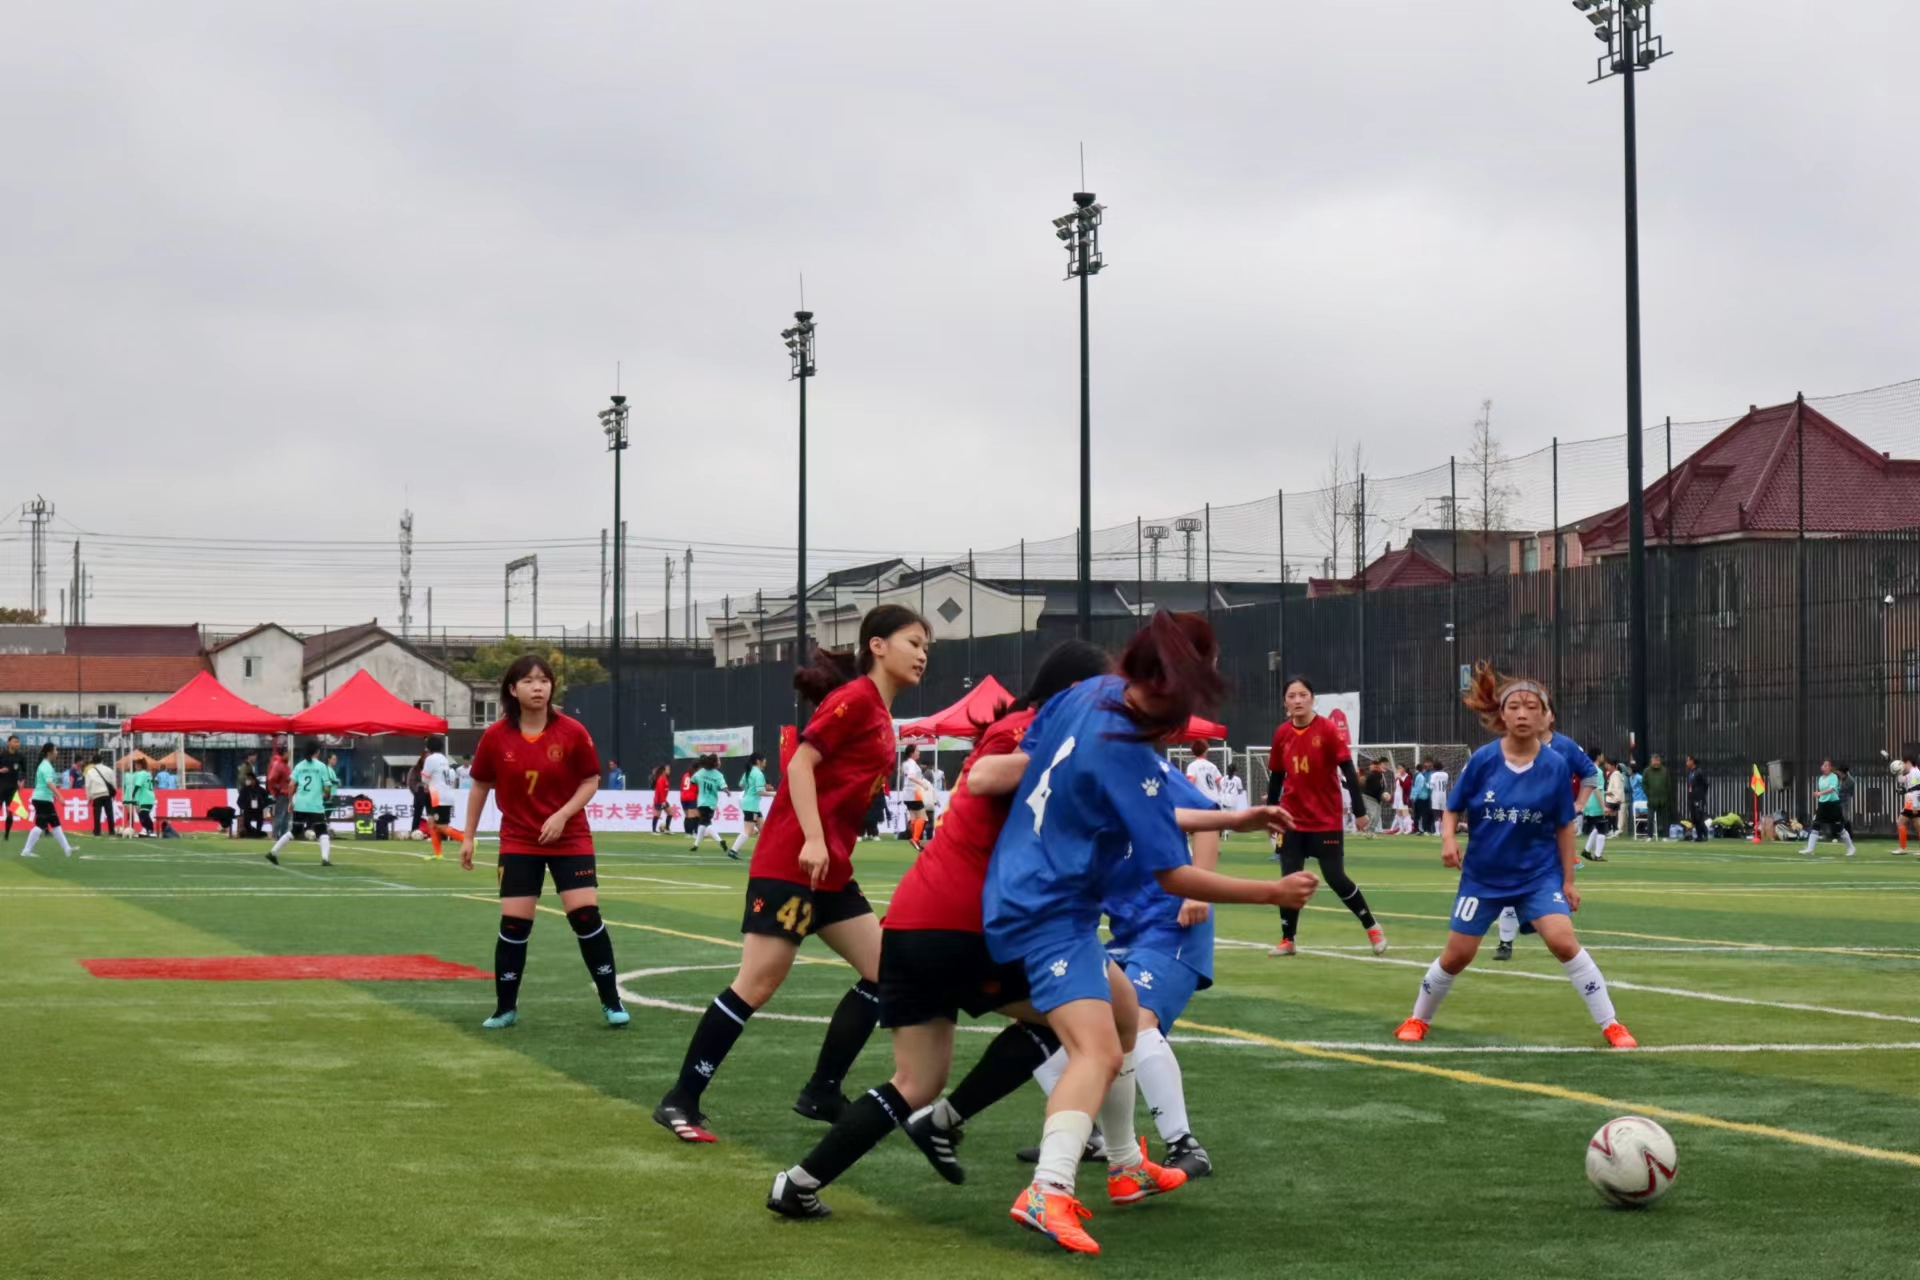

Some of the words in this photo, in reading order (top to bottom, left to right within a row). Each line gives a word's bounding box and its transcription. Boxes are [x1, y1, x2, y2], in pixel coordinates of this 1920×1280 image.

[1292, 756, 1310, 774] 14
[303, 776, 312, 792] 2
[525, 770, 539, 795] 7
[683, 776, 690, 790] 9
[1483, 807, 1543, 824] 上海商学院
[776, 896, 812, 937] 42
[1455, 896, 1479, 922] 10
